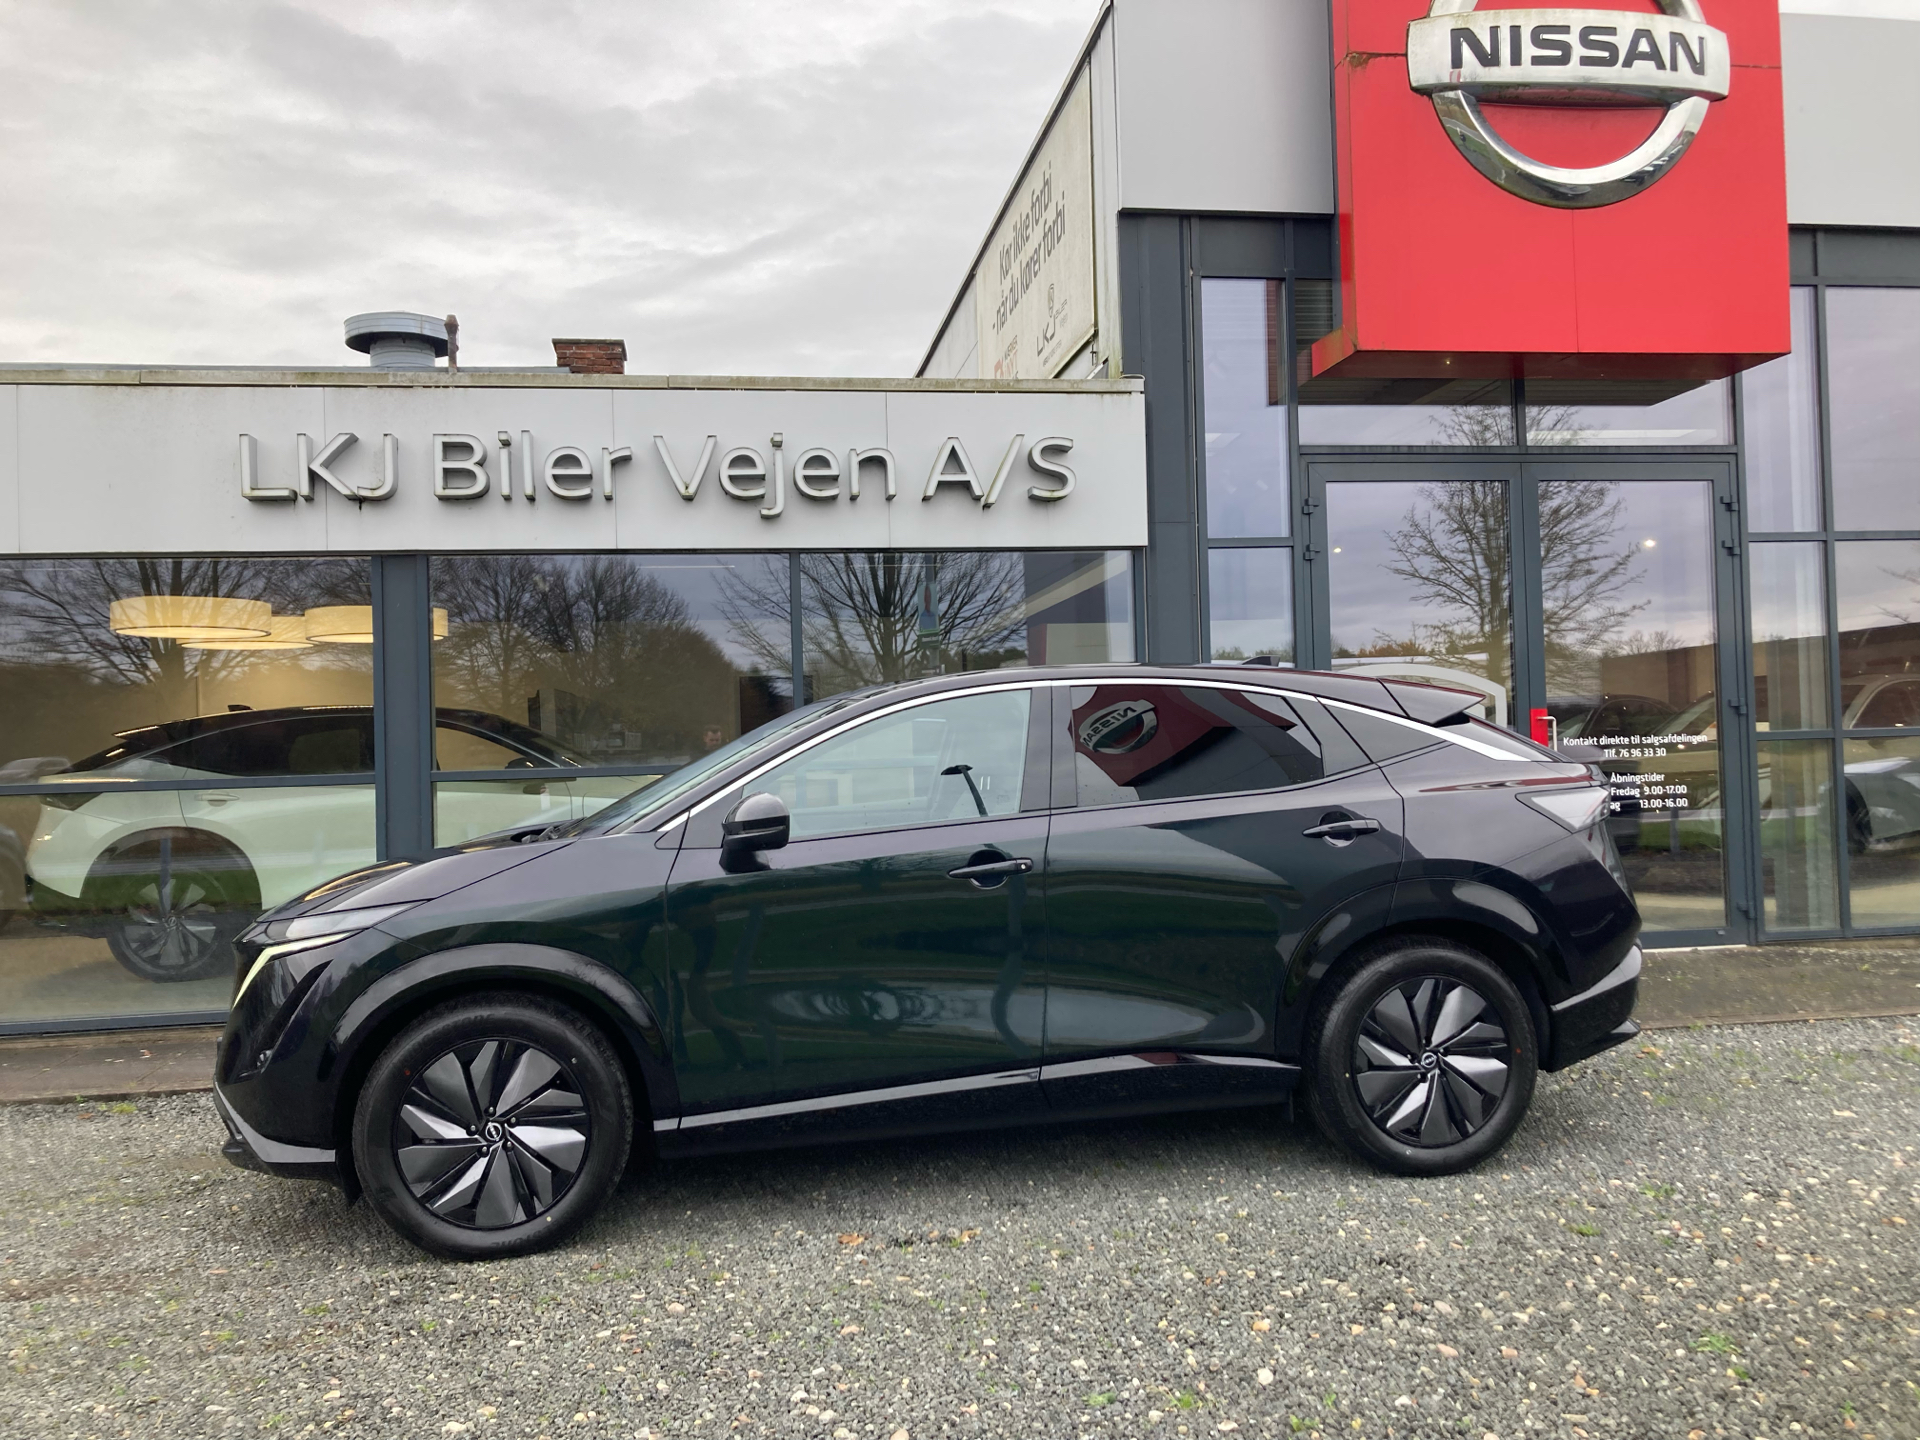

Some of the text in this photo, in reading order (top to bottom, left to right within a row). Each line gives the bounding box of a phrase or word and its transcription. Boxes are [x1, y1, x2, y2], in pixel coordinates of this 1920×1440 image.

[1450, 25, 1707, 76] NISSAN
[1013, 211, 1030, 263] ikke
[1031, 160, 1052, 233] forbi
[1009, 273, 1019, 316] du
[1043, 190, 1065, 264] forbi
[1036, 314, 1056, 357] LKJ
[239, 429, 1077, 519] LKJ Biler Vejen A/S
[1563, 733, 1708, 746] Kontakt direkte til salgsafdelingen
[1604, 748, 1666, 757] Tlf. 76 96 33 30
[1610, 772, 1665, 784] Åbningstider
[1610, 785, 1687, 797] Fredag 9.00-17.00
[1639, 798, 1688, 808] 13.00-16.00
